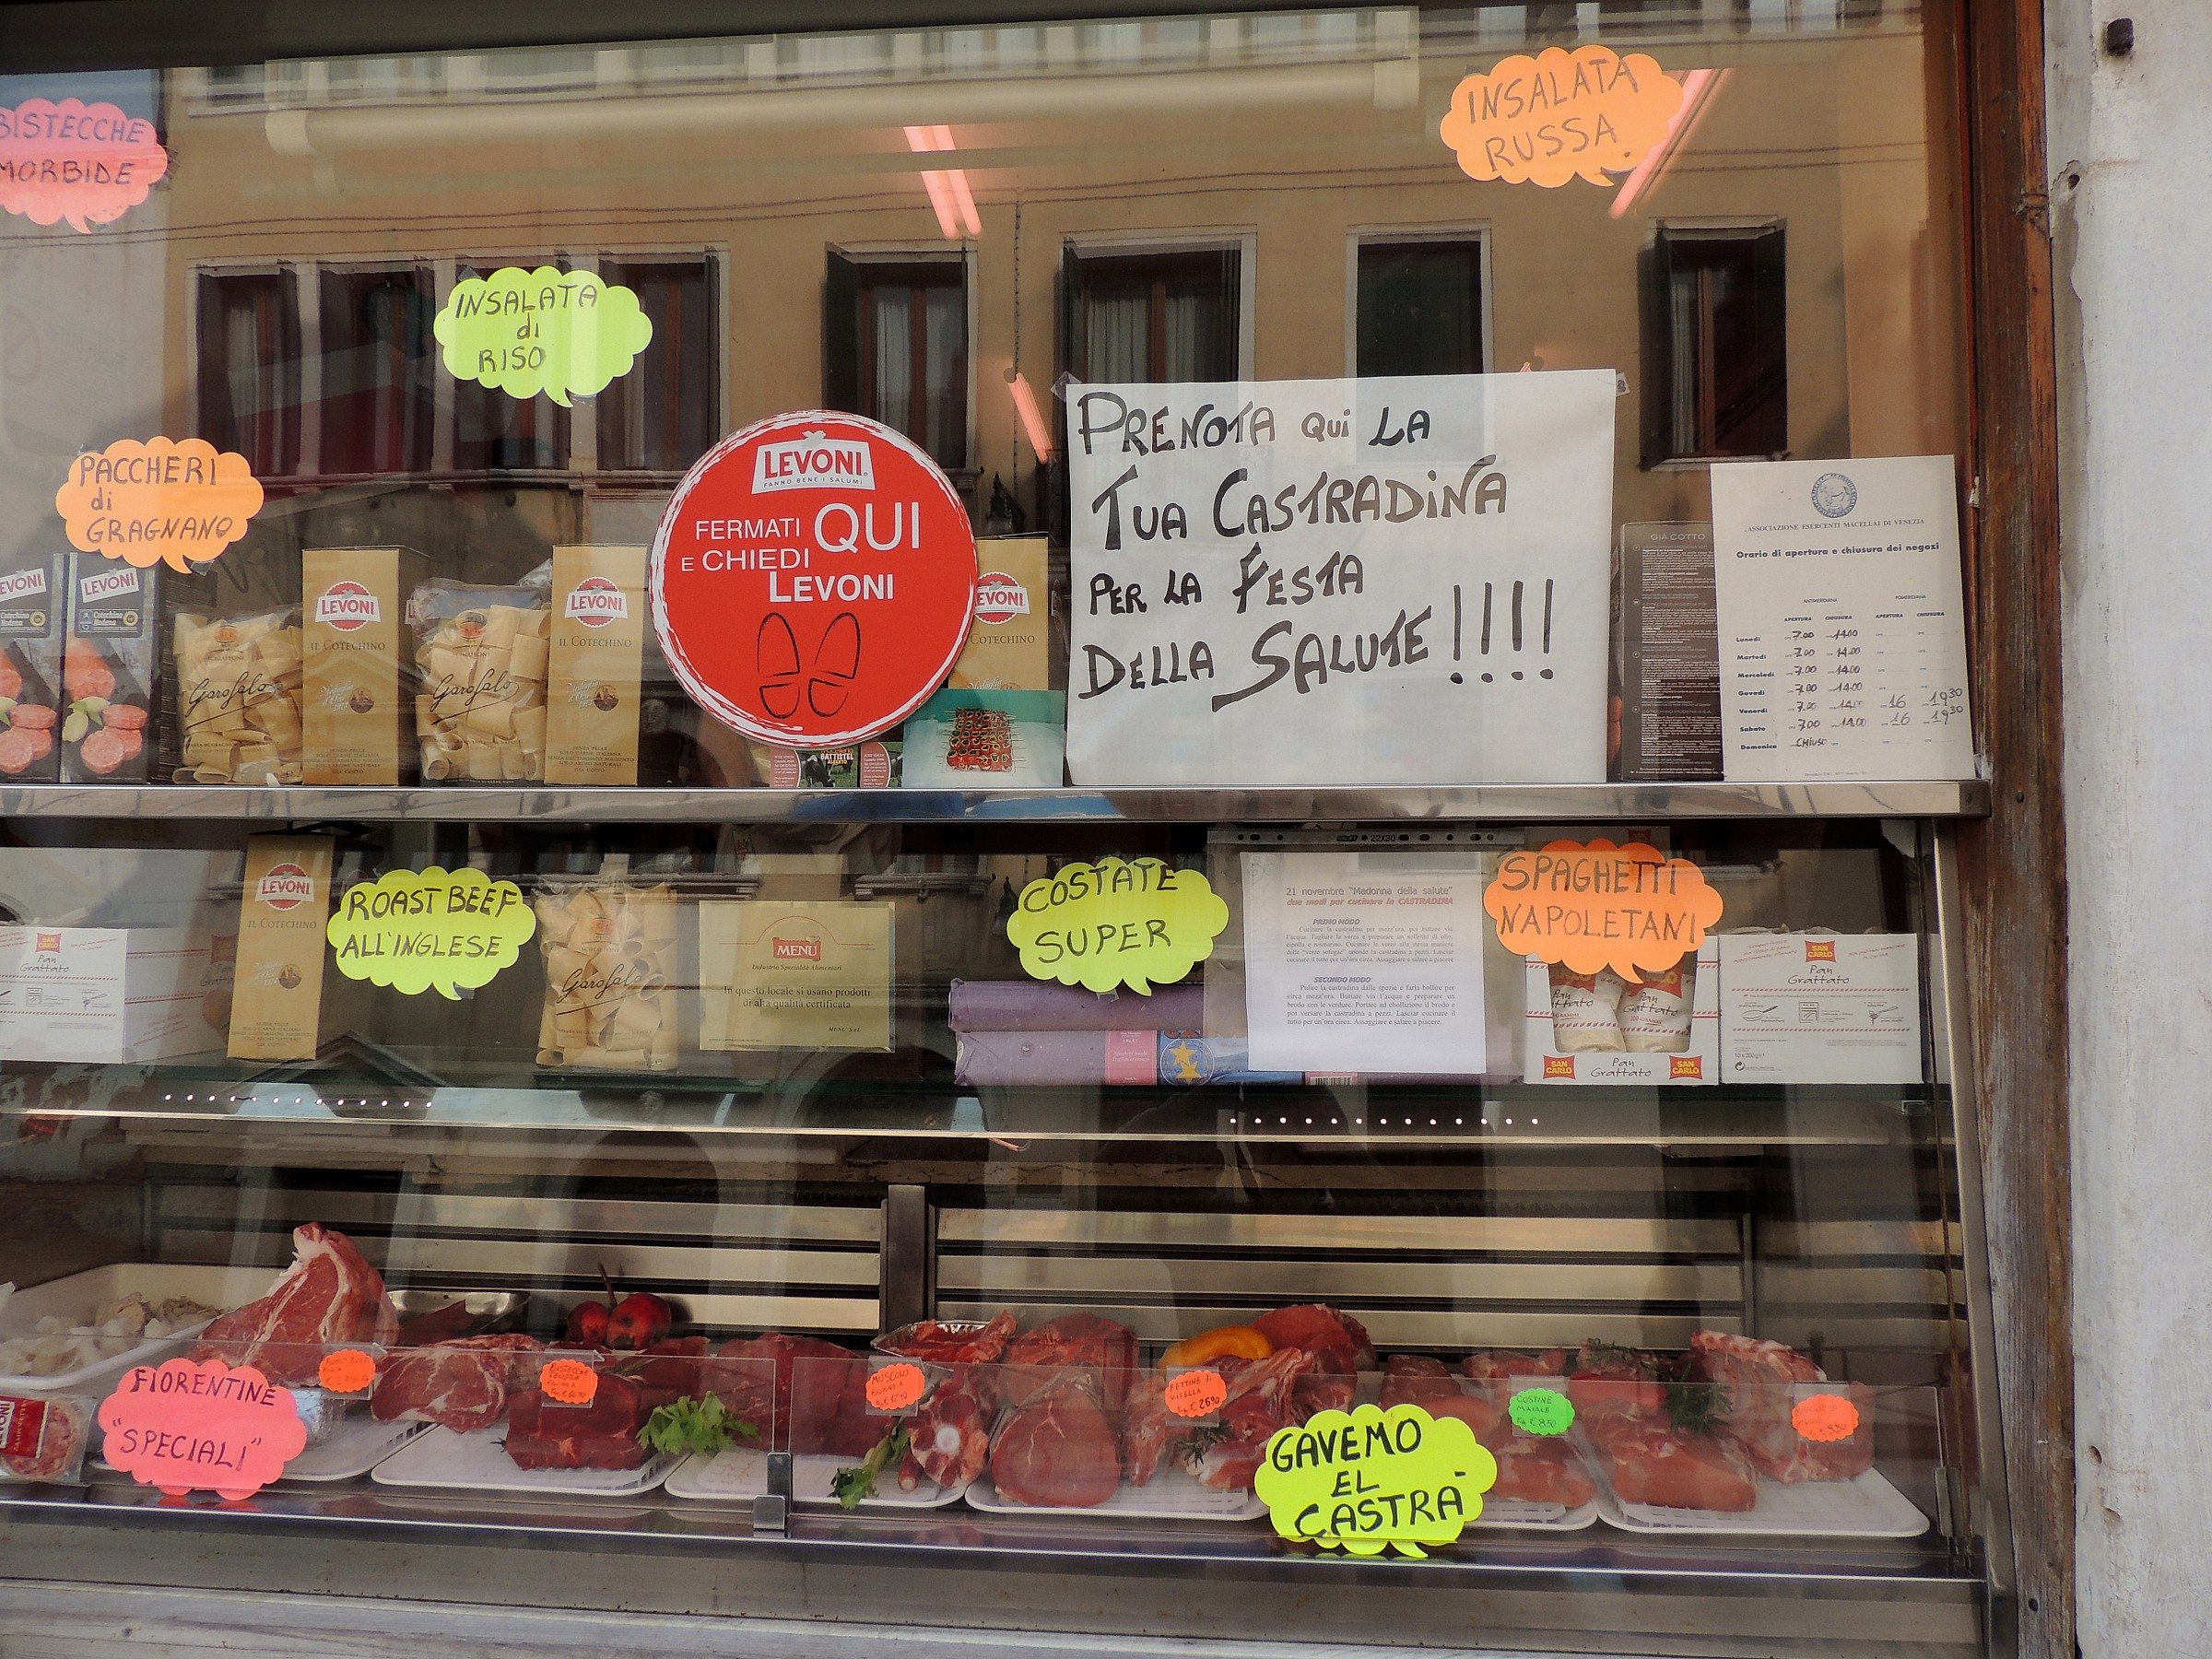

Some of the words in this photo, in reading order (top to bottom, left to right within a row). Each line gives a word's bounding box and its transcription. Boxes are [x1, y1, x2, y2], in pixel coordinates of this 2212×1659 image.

[1467, 57, 1640, 124] INSALATA
[0, 112, 147, 143] BISTECCHE
[454, 284, 598, 320] INSALATA
[516, 311, 540, 339] di
[478, 347, 546, 372] RISO
[1077, 391, 1277, 456] PRENOTA
[1369, 406, 1431, 447] LA
[78, 455, 218, 487] PACCHERI
[764, 449, 862, 478] LEVONI
[763, 477, 792, 488] FANNO
[830, 477, 864, 485] SALUMI
[91, 487, 112, 512] di
[1091, 464, 1189, 551] TUA
[86, 516, 233, 545] GRAGNANO
[695, 517, 801, 541] FERMATI
[814, 501, 921, 554] QUI
[1802, 522, 1841, 530] ESERCENTI
[1843, 520, 1880, 528] MACELLAI
[1669, 532, 1706, 541] COTTO
[1736, 549, 1769, 559] Orario
[1771, 548, 1782, 558] di
[1784, 547, 1829, 558] apertura
[1841, 544, 1883, 554] chiusura
[1886, 543, 1902, 552] dei
[1905, 541, 1940, 553] negozi
[681, 557, 695, 572] E
[701, 547, 810, 572] CHIEDI
[0, 573, 42, 595] EVONI
[84, 572, 135, 596] LEVONI
[1089, 571, 1147, 616] PER
[1163, 568, 1203, 606] LA
[1232, 541, 1364, 614] FESTA
[769, 571, 894, 603] LEVONI
[571, 594, 624, 612] LEVONI
[977, 591, 1025, 607] EVONI
[321, 599, 374, 616] LEVONI
[324, 640, 386, 651] COTECHINO
[571, 635, 632, 647] COTECHINO
[970, 633, 1035, 645] COTECHINO
[1077, 641, 1216, 700] DELLA
[185, 670, 274, 724] Garofalo
[429, 668, 518, 719] Garofalo
[1888, 694, 1907, 709] 16
[1890, 712, 1911, 726] 16
[1501, 854, 1677, 896] SPAGHETTI
[261, 879, 311, 895] LEVONI
[1023, 862, 1179, 913] COSTATE
[1286, 887, 1297, 896] 21
[1301, 887, 1345, 896] novembre
[1397, 887, 1418, 896] della
[347, 887, 443, 922] ROAST
[446, 885, 520, 919] BEEF
[1286, 898, 1302, 906] due
[1329, 899, 1344, 907] per
[1385, 897, 1394, 905] la
[1397, 897, 1453, 905] CASTRADINA
[260, 917, 317, 930] COTECHINO
[1499, 902, 1697, 945] NAPOLETANI
[339, 931, 503, 959] ALL'INGLESE
[1034, 919, 1172, 964] SUPER
[1811, 945, 1829, 953] SAN
[776, 944, 818, 957] MENU
[1807, 950, 1833, 959] CARLO
[37, 954, 56, 964] Pan
[19, 962, 70, 974] Grattato
[1809, 964, 1833, 975] Pan
[556, 962, 656, 1007] Garofalo
[1787, 974, 1850, 986] Grattato
[723, 985, 734, 994] In
[735, 986, 765, 997] questo
[767, 985, 794, 995] locale
[796, 986, 805, 995] si
[835, 987, 871, 998] prodotti
[1553, 988, 1571, 1000] Pan
[1639, 991, 1658, 1004] Pan
[742, 998, 752, 1007] di
[754, 998, 771, 1007] alta
[773, 999, 804, 1009] qualità
[806, 999, 851, 1008] certificata
[1353, 1018, 1387, 1027] Assaggiare
[1545, 1066, 1572, 1075] CARLO
[1550, 1060, 1568, 1068] SAN
[1612, 1057, 1635, 1068] Pan
[1672, 1066, 1700, 1075] CARLO
[1676, 1060, 1695, 1068] SAN
[1590, 1067, 1652, 1078] Grattato
[129, 1368, 277, 1407] FIORENTINE
[1170, 1378, 1202, 1392] FETTINE
[1169, 1389, 1202, 1401] VITELLA
[1516, 1394, 1553, 1404] COSTINE
[1516, 1406, 1550, 1414] MAIALE
[1271, 1417, 1422, 1473] GAVEMO
[1330, 1469, 1381, 1498] EL
